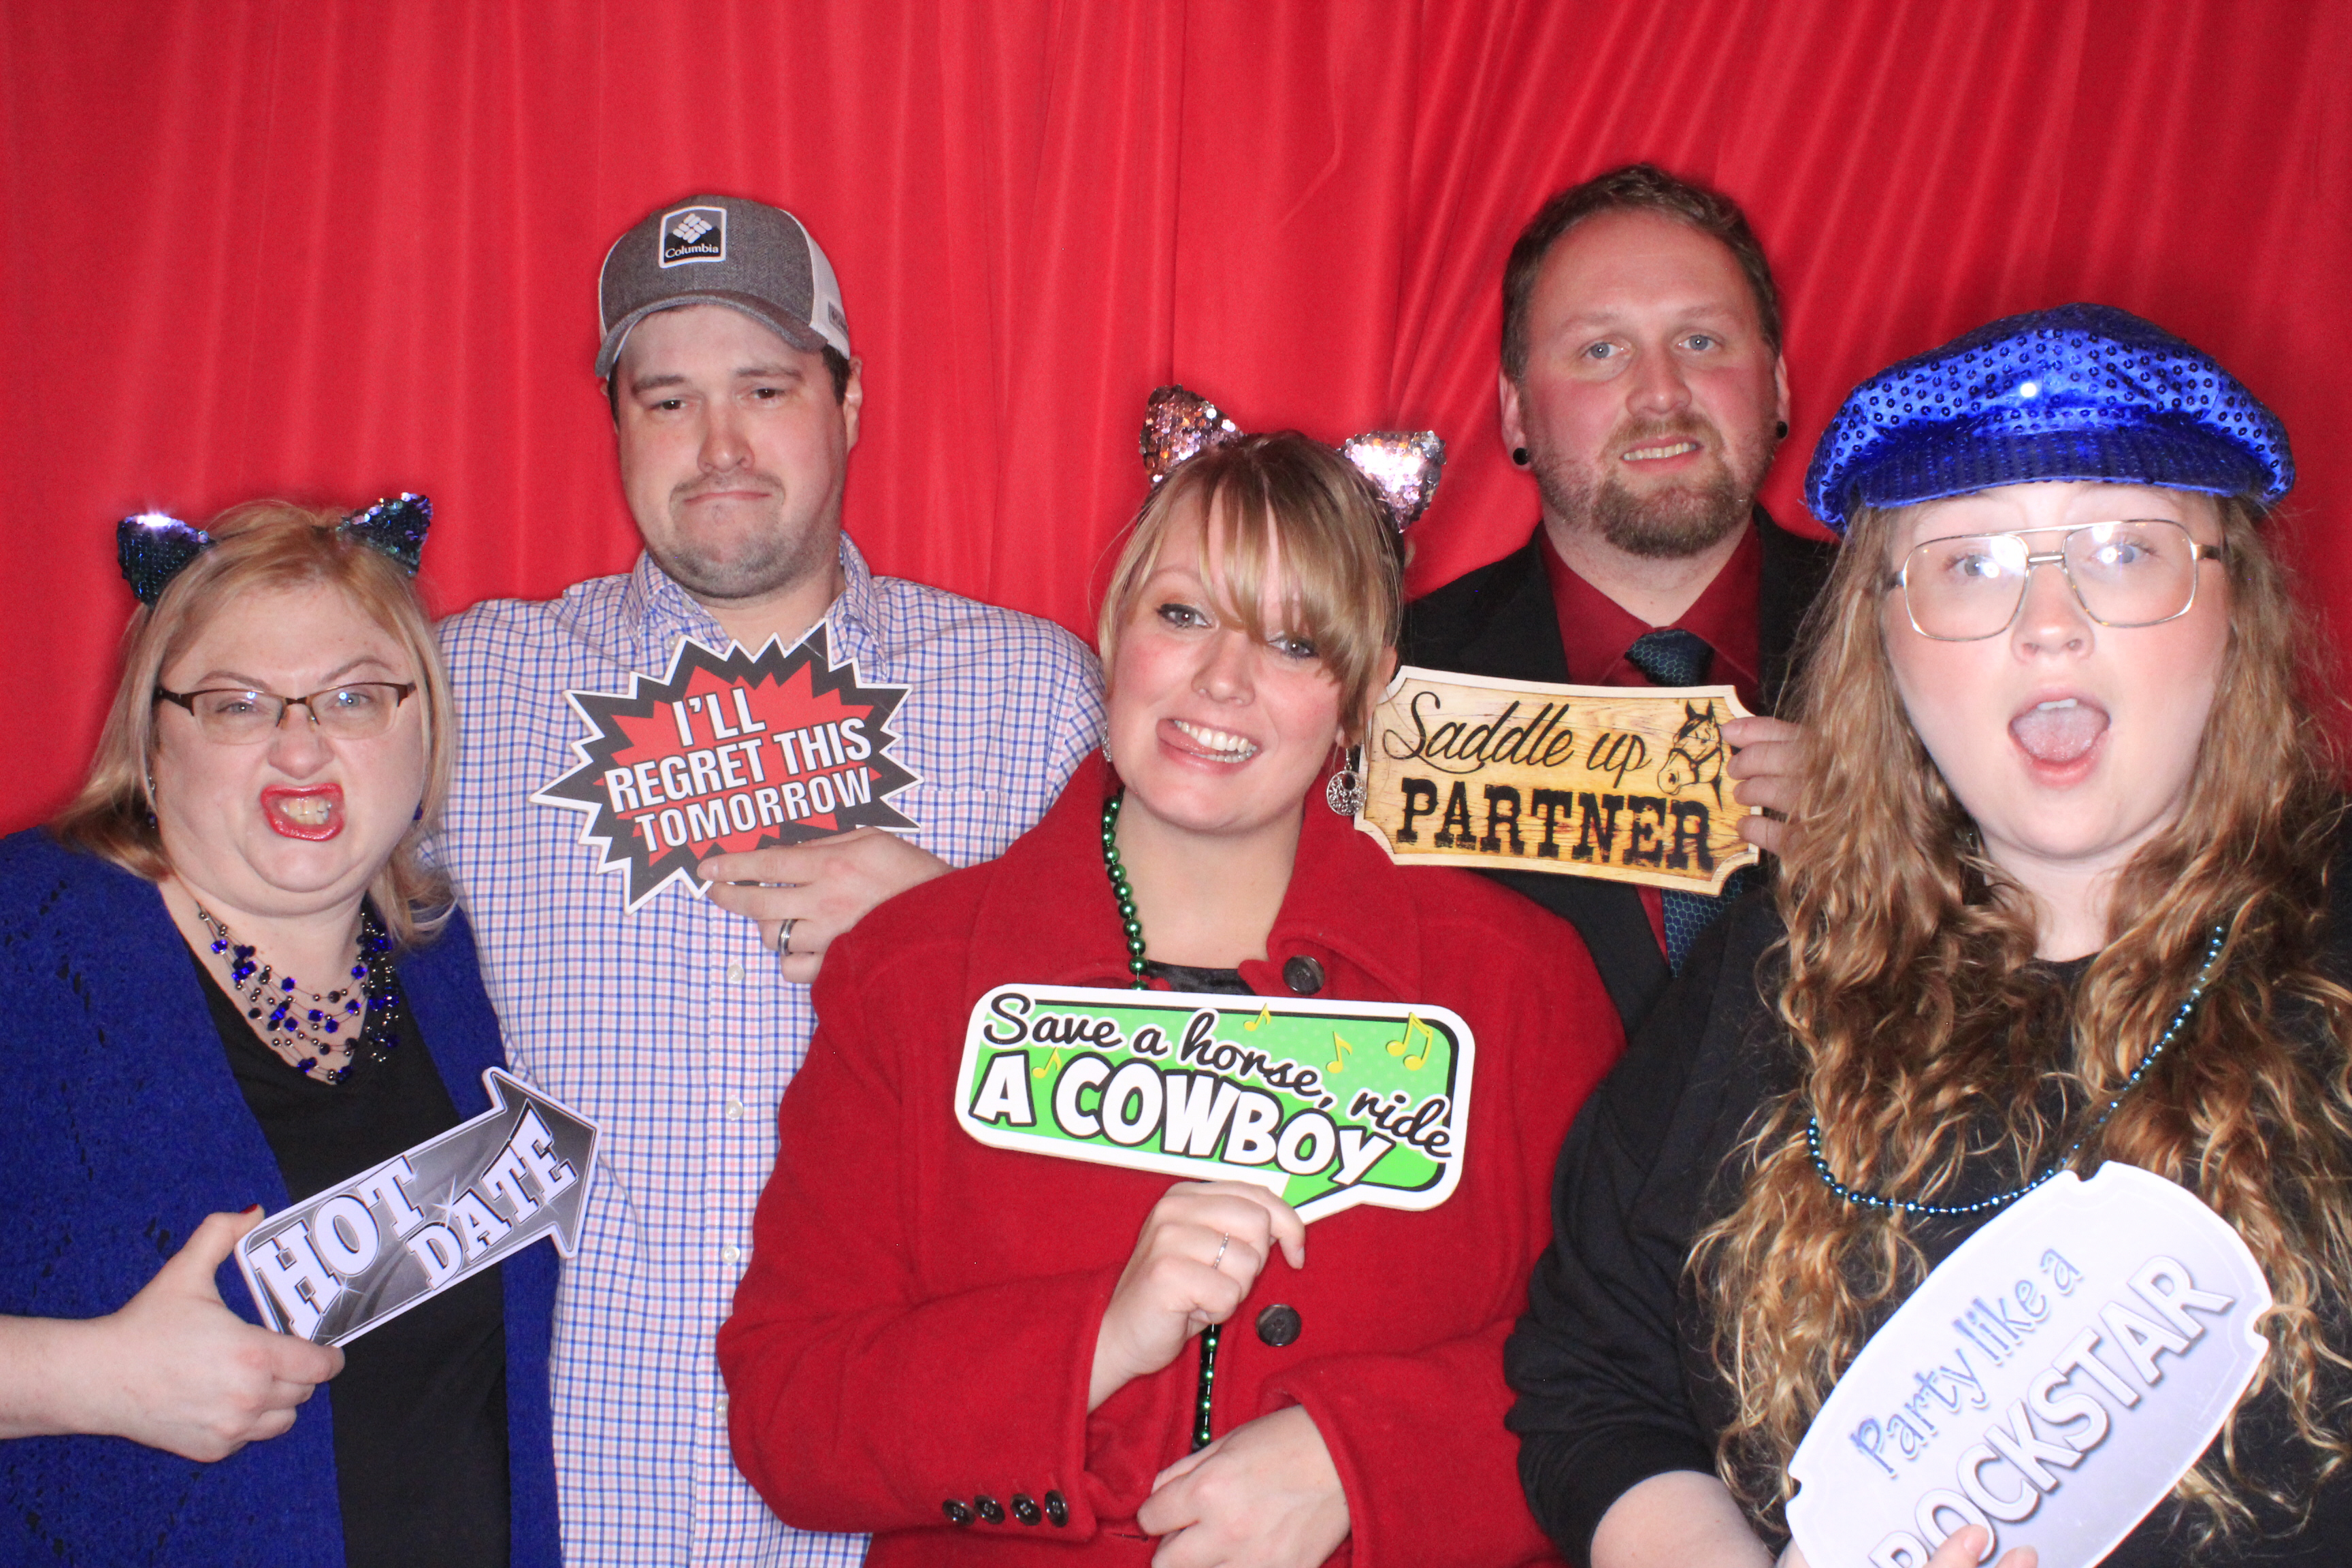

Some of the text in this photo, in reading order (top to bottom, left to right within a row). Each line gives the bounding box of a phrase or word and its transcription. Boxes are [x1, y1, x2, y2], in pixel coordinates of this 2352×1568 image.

[665, 243, 719, 259] Columbia
[604, 717, 872, 813] REGRET THIS
[672, 687, 766, 747] I'LL
[1382, 691, 1652, 788] Saddle up
[634, 766, 872, 852] TOMORROW
[1396, 777, 1714, 871] PARTNER
[969, 1049, 1396, 1186] A COWBOY
[983, 992, 1452, 1158] Save a horse, ride
[405, 1102, 578, 1290] DATE
[246, 1156, 425, 1340] HOT
[1850, 1247, 2084, 1475] Party like a
